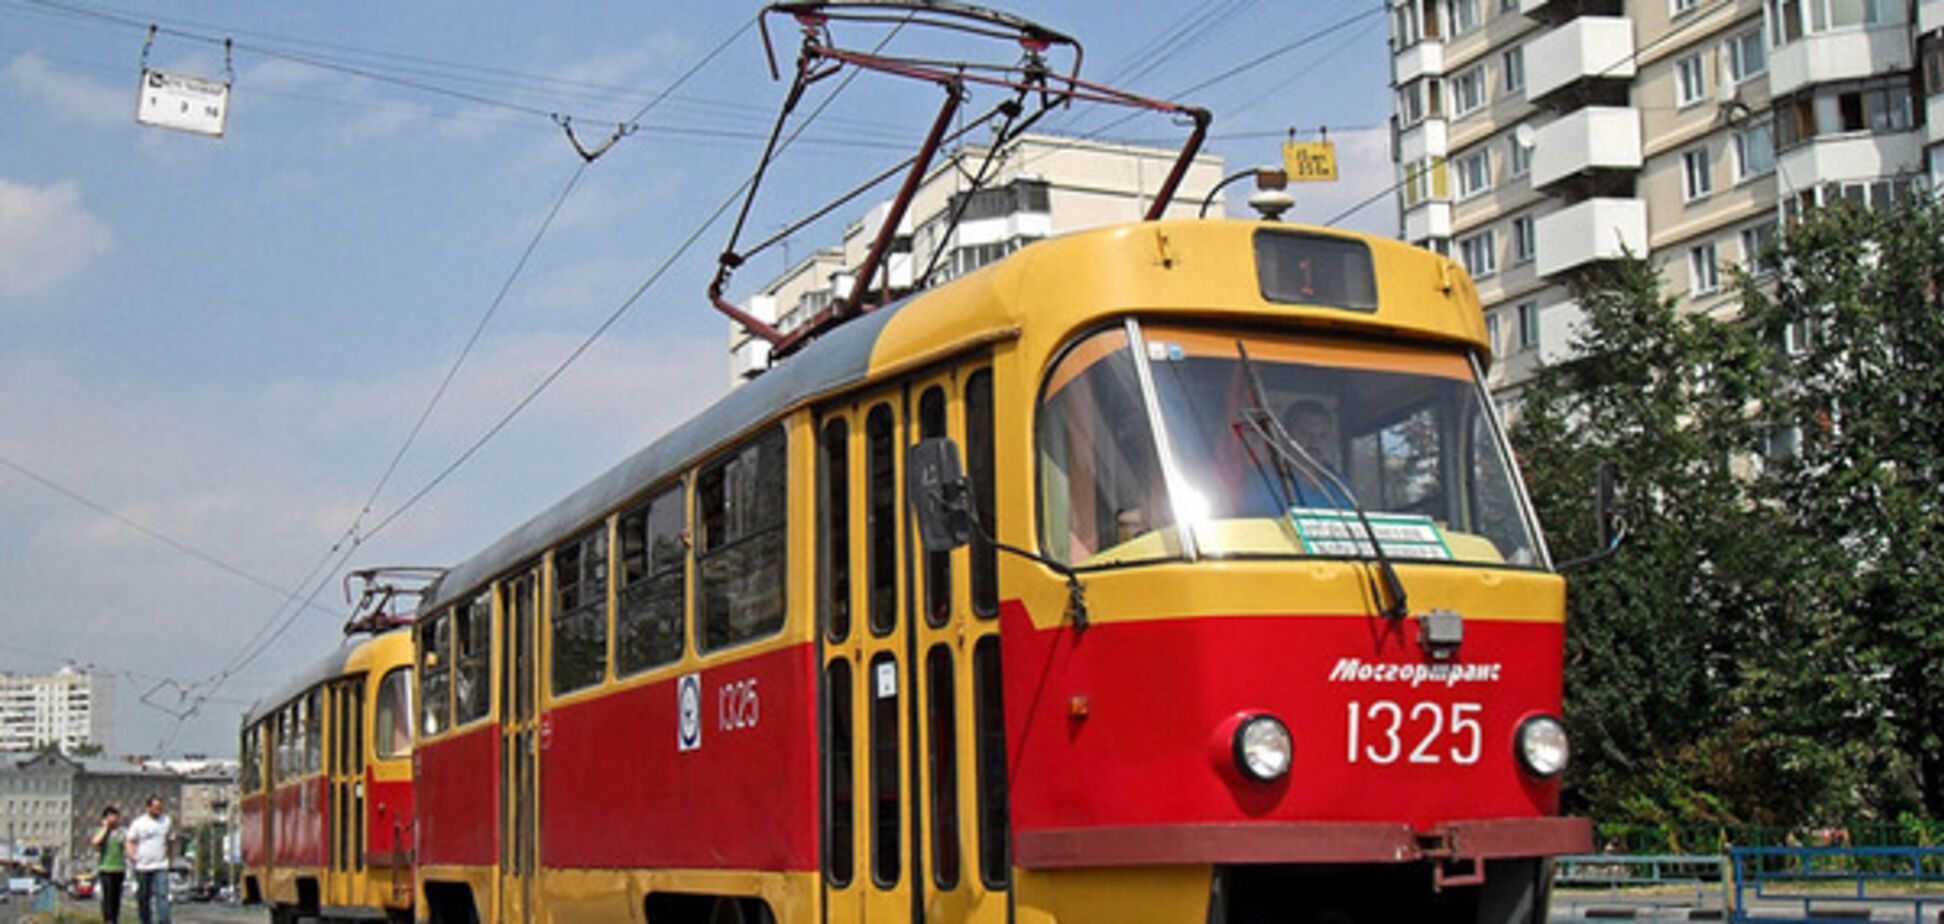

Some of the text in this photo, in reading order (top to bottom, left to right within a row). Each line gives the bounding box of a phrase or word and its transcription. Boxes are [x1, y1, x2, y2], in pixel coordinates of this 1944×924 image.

[1328, 656, 1502, 688] Мосгортранс
[718, 677, 760, 732] 1325
[1347, 700, 1483, 765] 1325
